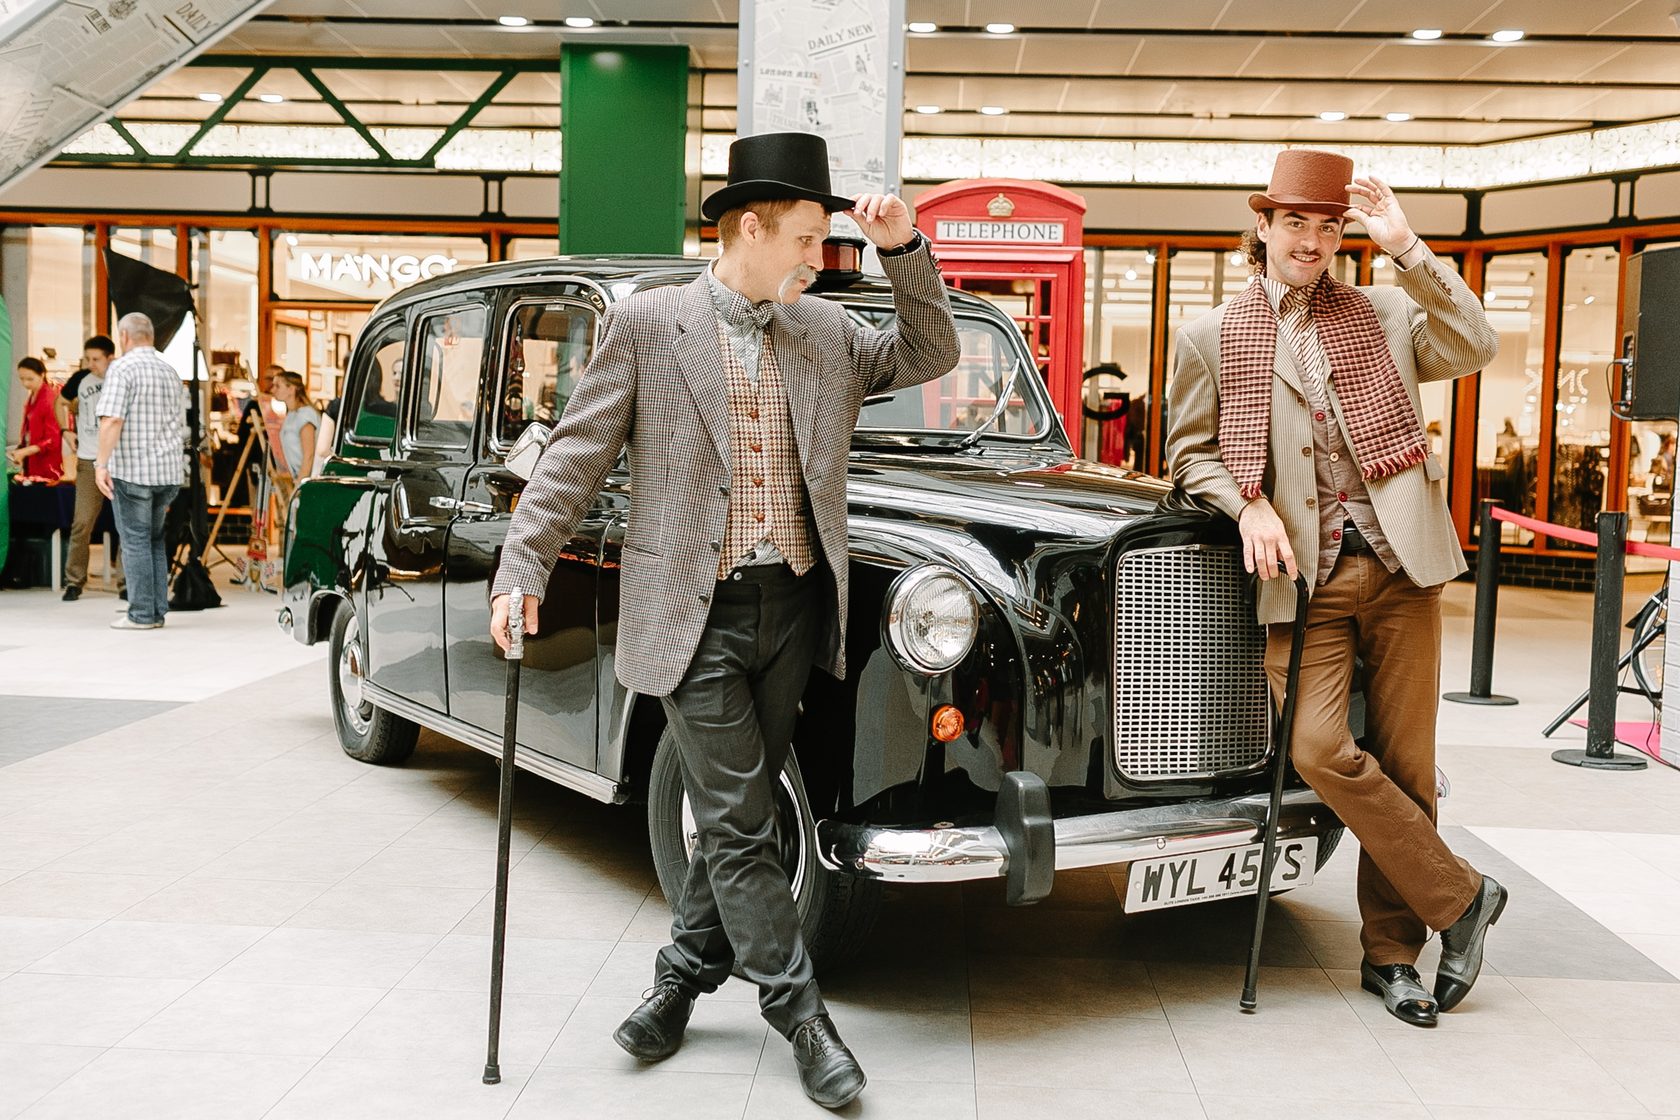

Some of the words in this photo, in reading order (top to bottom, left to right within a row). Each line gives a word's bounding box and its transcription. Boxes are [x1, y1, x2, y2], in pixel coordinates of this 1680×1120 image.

[176, 2, 218, 33] DAILY
[808, 28, 845, 50] DAILY
[942, 222, 1059, 240] TELEPHONE
[301, 252, 457, 282] MANGO
[1141, 858, 1205, 903] WYL
